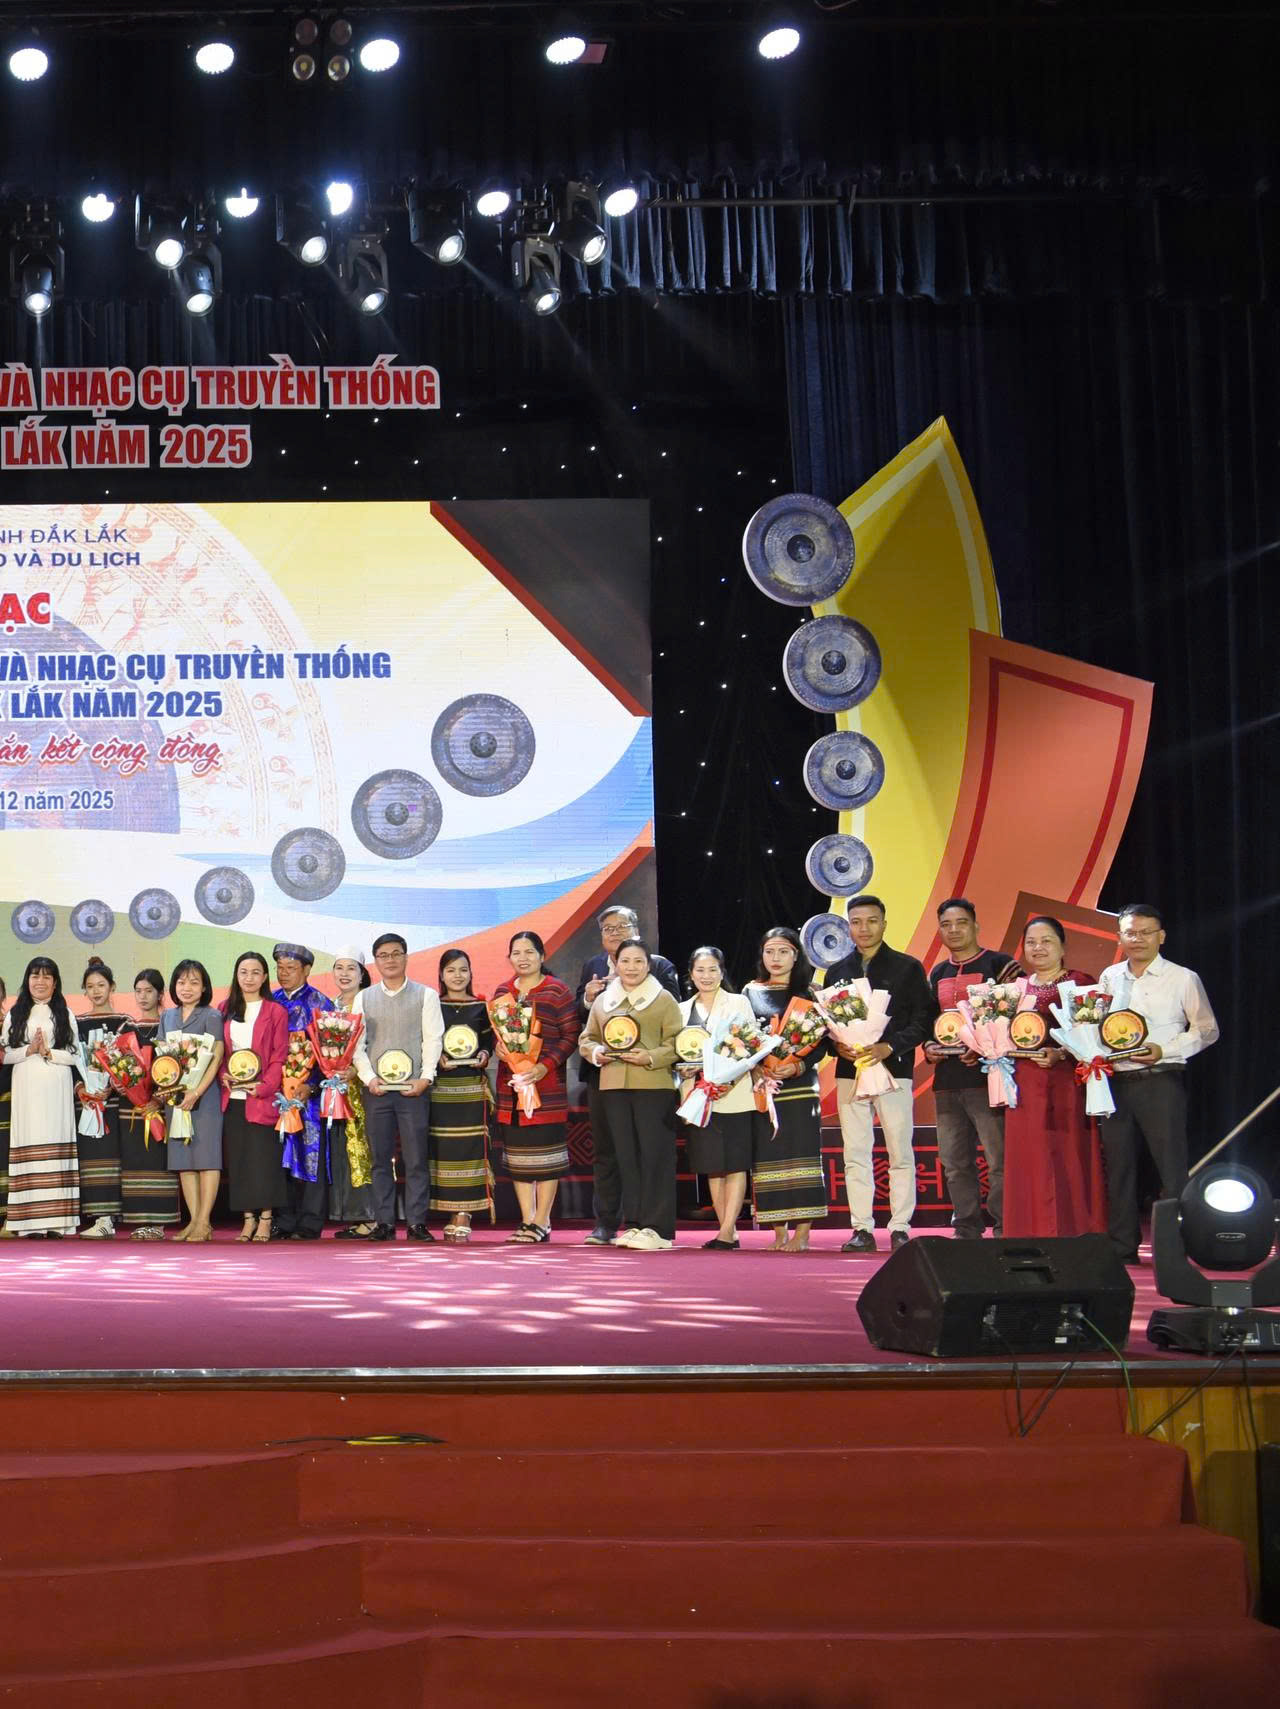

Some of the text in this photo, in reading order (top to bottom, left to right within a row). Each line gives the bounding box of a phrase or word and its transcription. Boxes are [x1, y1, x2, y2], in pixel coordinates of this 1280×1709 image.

[46, 371, 132, 414] NHẠC
[142, 371, 185, 413] CỤ
[195, 359, 316, 407] TRUYỀN
[328, 358, 435, 405] THỐNG
[5, 420, 65, 466] LẮK
[75, 424, 146, 464] NĂM
[164, 428, 248, 465] 2025
[30, 524, 75, 543] ĐẮK
[85, 523, 127, 543] LẮK
[14, 549, 42, 567] VÀ
[51, 553, 82, 566] DU
[91, 552, 140, 568] LỊCH
[38, 654, 115, 685] NHẠC
[126, 654, 165, 684] CỤ
[174, 645, 284, 680] TRUYỀN
[294, 644, 390, 679] THỐNG
[11, 686, 65, 718] LẮK
[72, 689, 136, 718] NĂM
[147, 692, 222, 717] 2025
[41, 734, 81, 760] kết
[91, 739, 146, 773] cộng
[159, 732, 222, 773] đồng
[24, 791, 64, 809] năm
[70, 791, 114, 809] 2025
